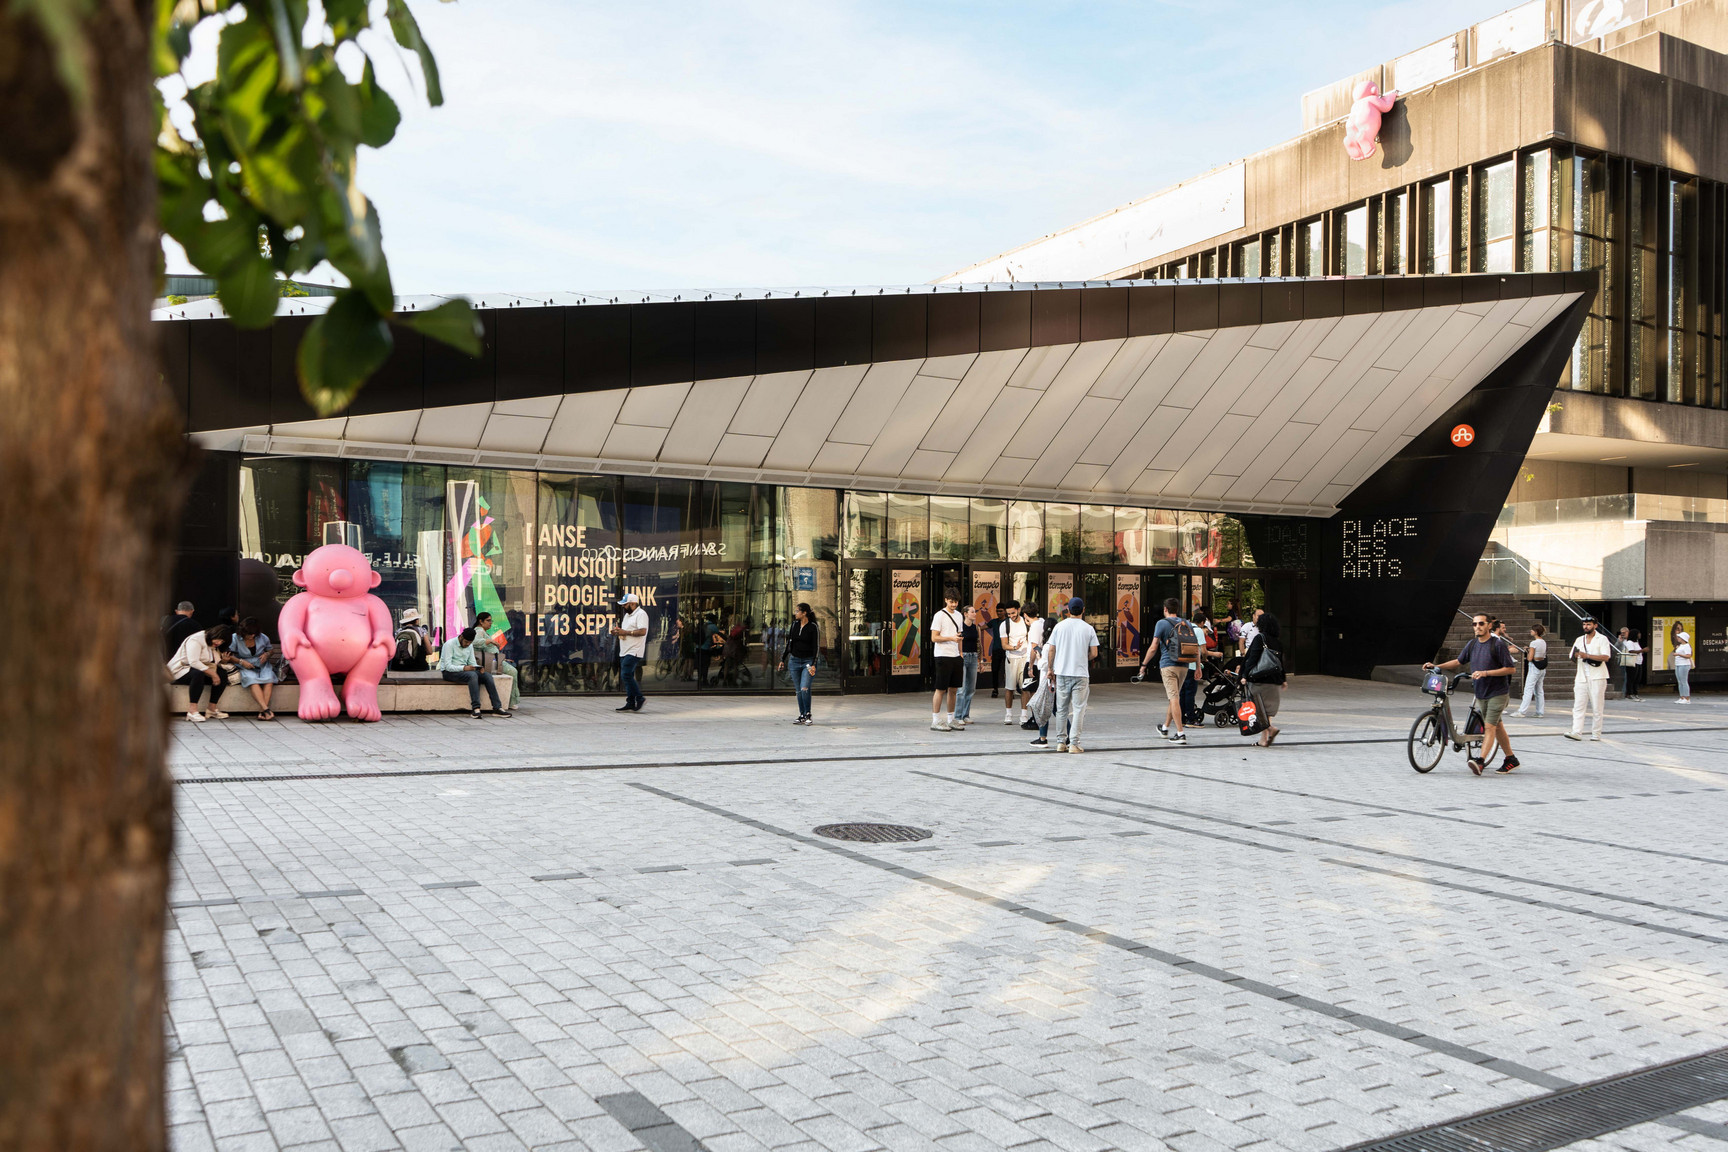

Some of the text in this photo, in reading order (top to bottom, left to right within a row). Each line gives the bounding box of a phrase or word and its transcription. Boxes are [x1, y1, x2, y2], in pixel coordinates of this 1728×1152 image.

[1343, 517, 1418, 539] PLACE
[1343, 539, 1386, 558] DES
[525, 554, 547, 577] ET
[1343, 559, 1402, 578] ARTS
[525, 613, 616, 637] LE 13 SEPT
